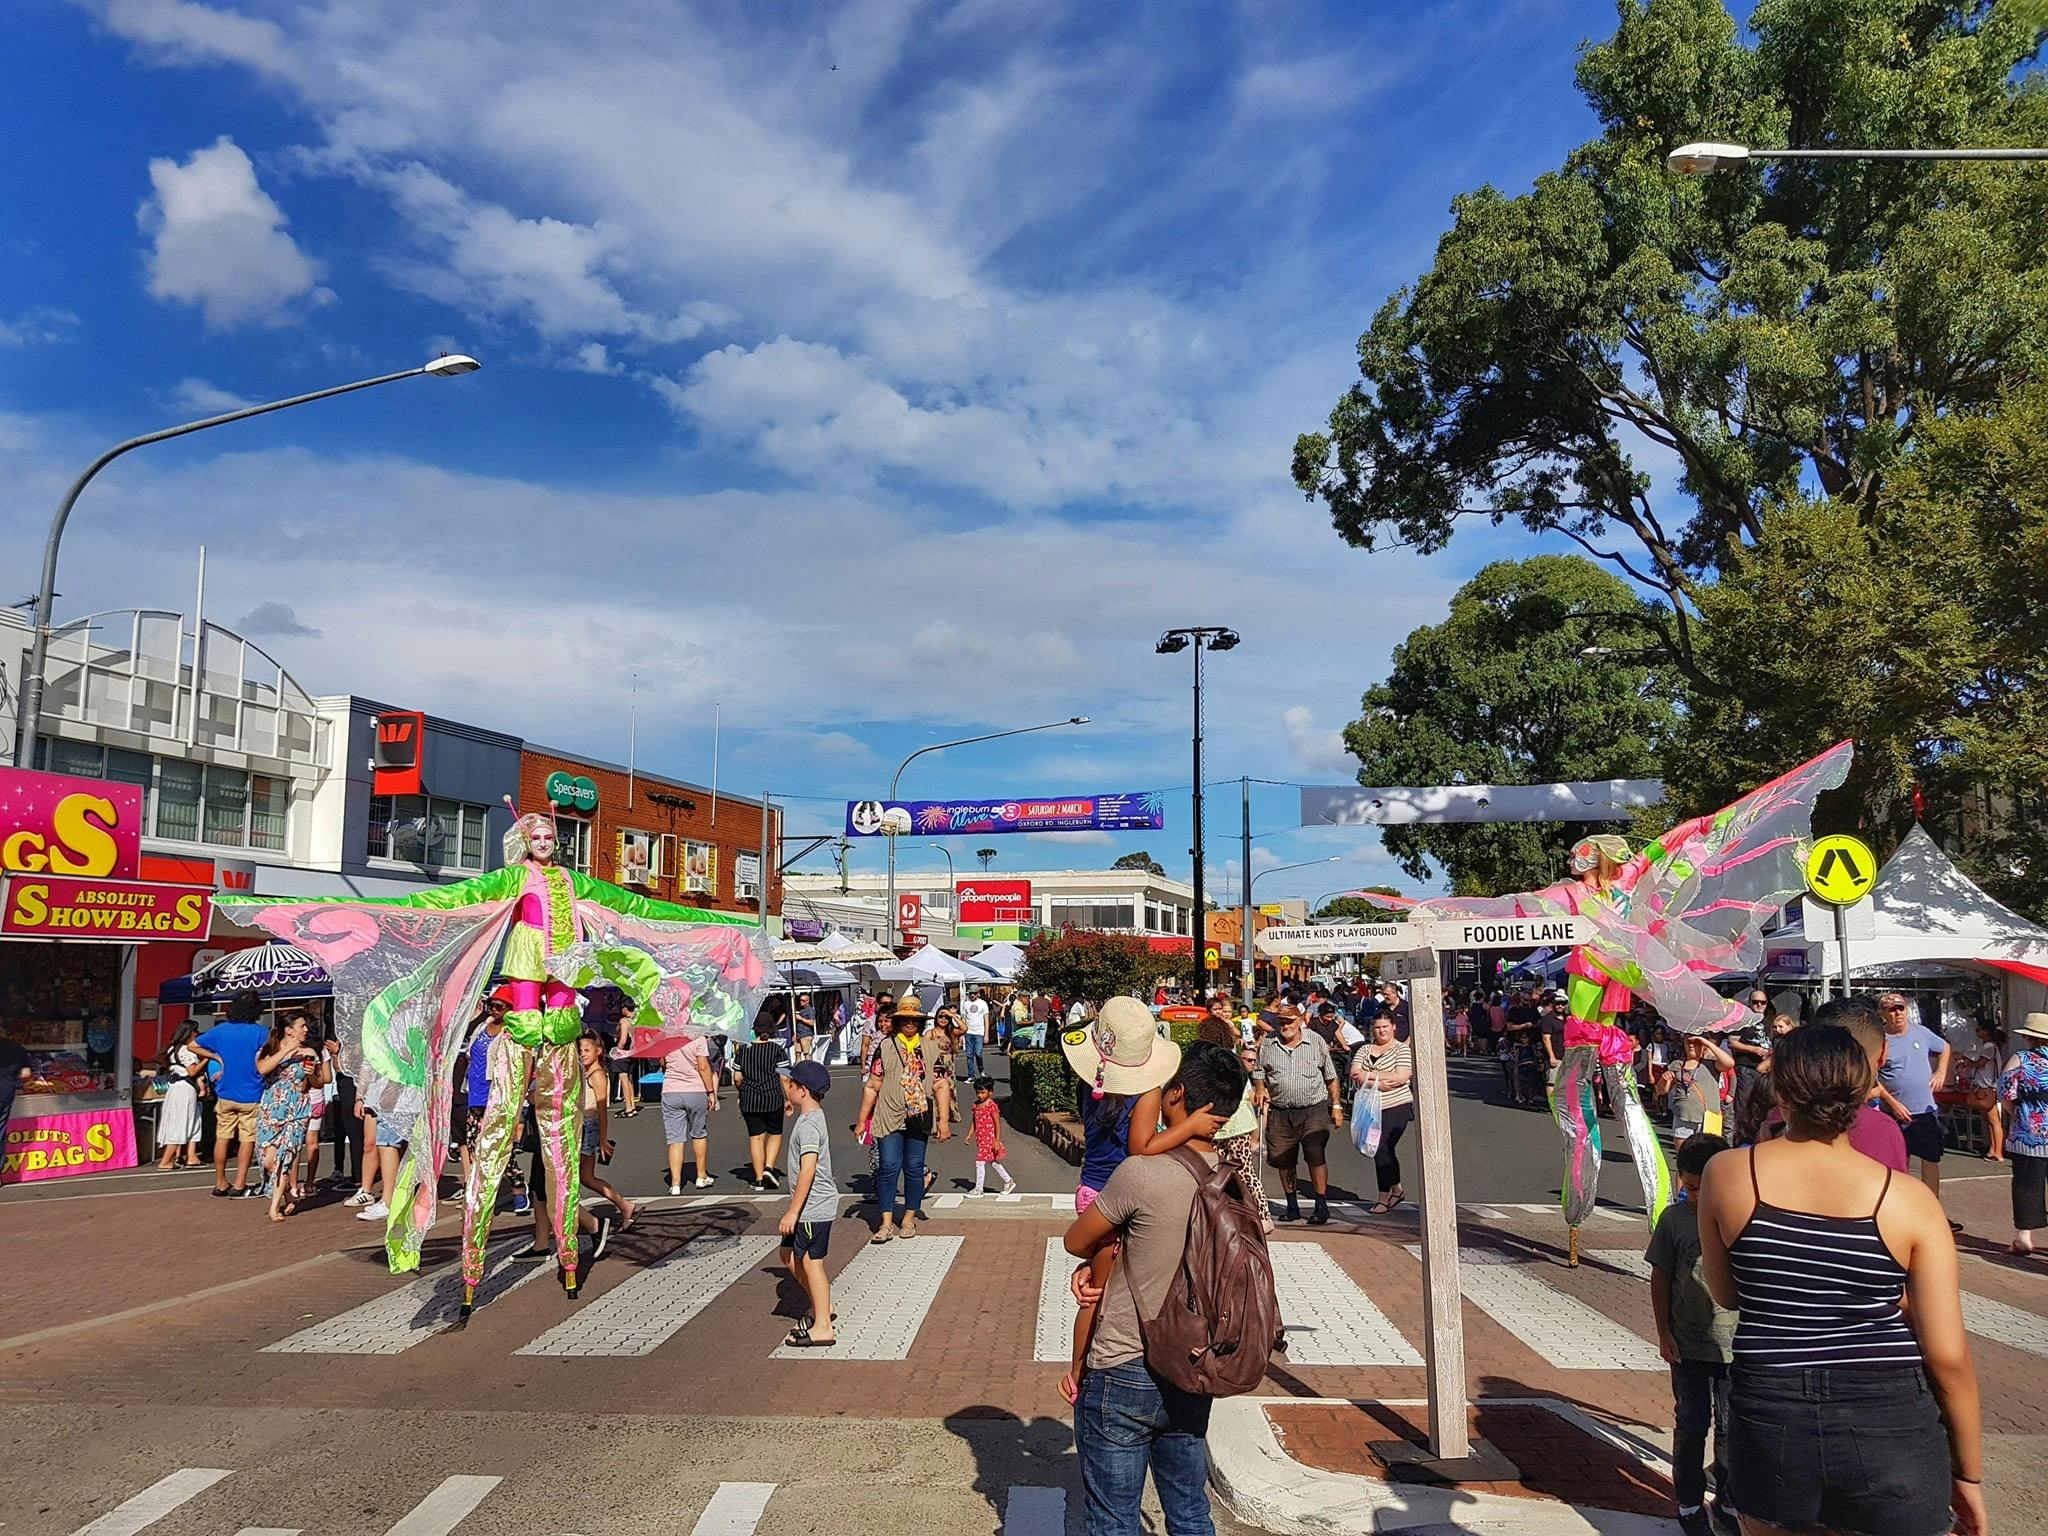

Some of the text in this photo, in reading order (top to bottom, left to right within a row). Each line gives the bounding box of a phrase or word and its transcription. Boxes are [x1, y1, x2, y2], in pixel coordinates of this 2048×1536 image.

[553, 780, 595, 800] Specsavers
[1028, 804, 1055, 816] SATURDAY
[1056, 804, 1061, 814] 2
[1062, 803, 1082, 814] MARCH
[950, 812, 989, 830] Alive
[0, 793, 118, 877] GS
[76, 890, 156, 907] ABSOLUTE
[961, 893, 1021, 903] propertypeople
[13, 884, 202, 932] SHOWBAGS
[1268, 927, 1397, 940] ULTIMATE KIDS PLAYGROUND
[1464, 923, 1575, 943] FOODIE LANE
[7, 1130, 71, 1145] OLUTE
[1, 1123, 114, 1173] WBAGS
